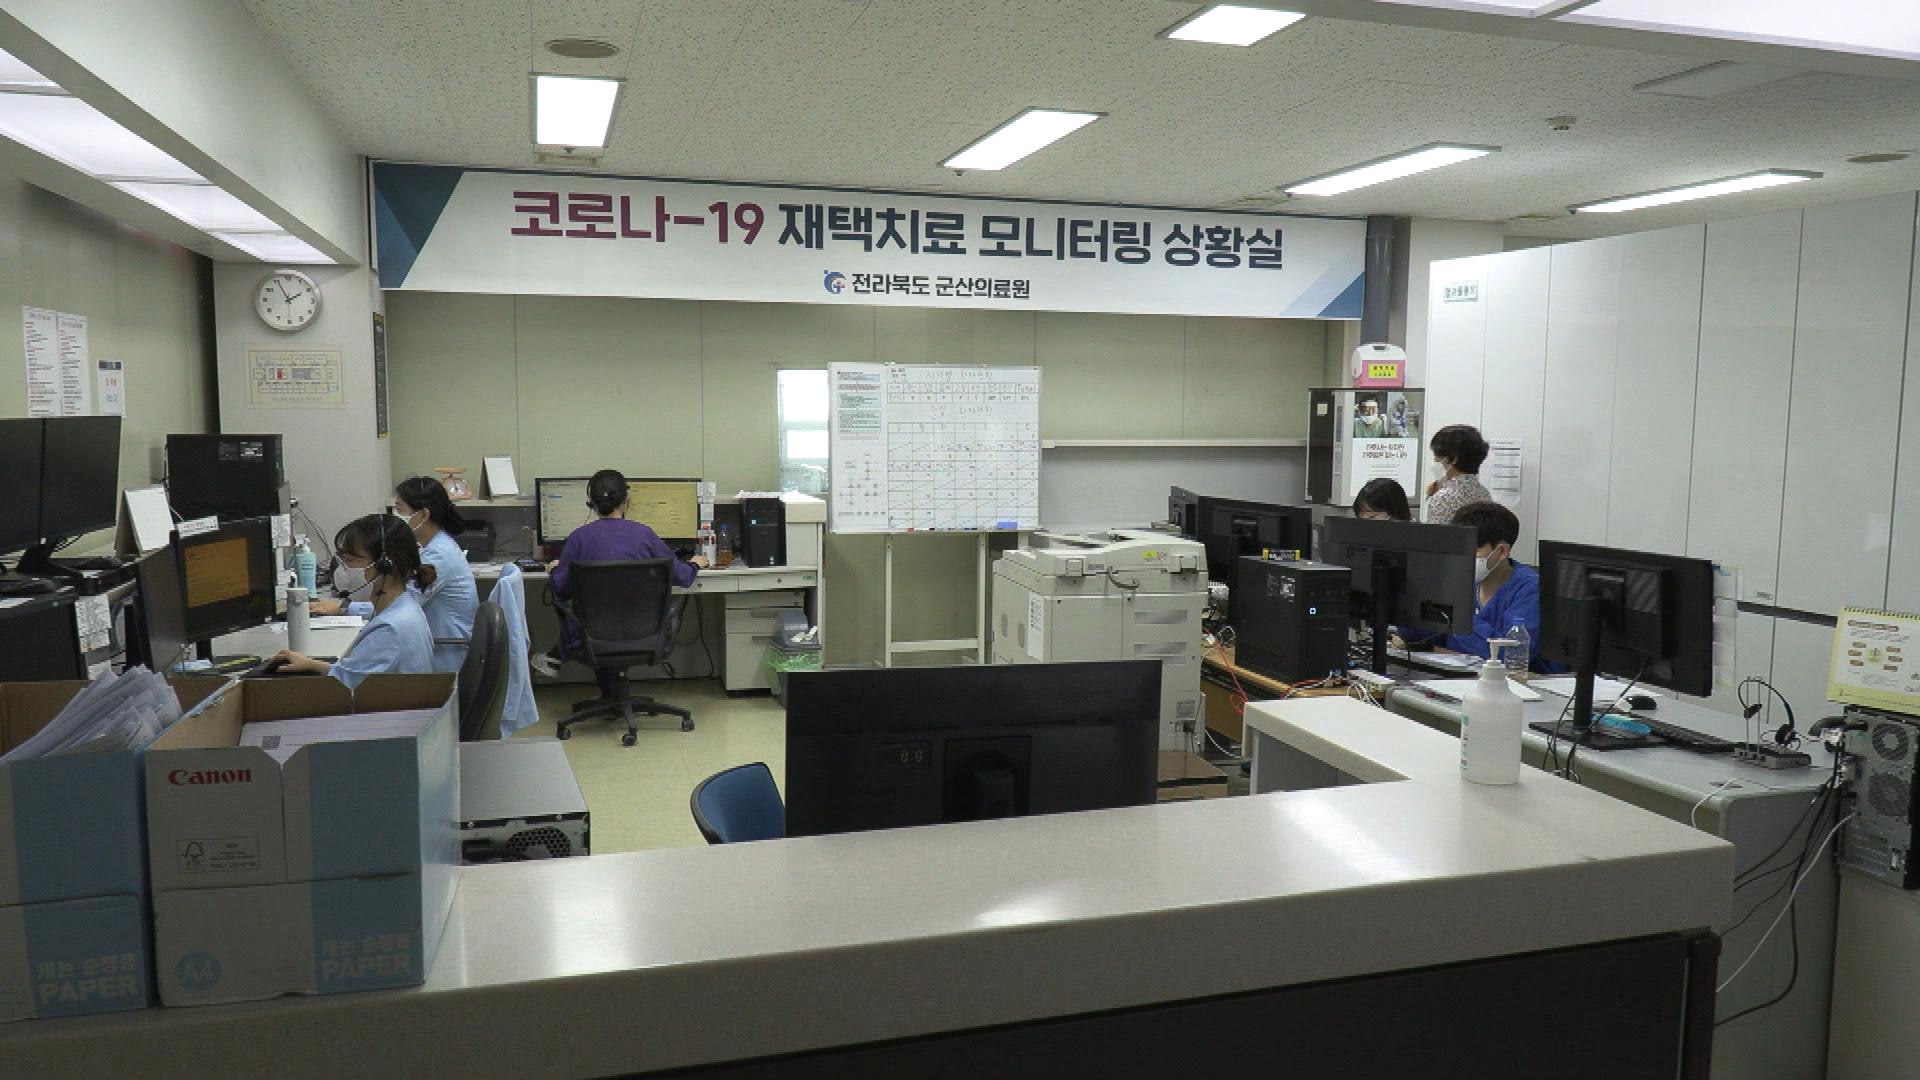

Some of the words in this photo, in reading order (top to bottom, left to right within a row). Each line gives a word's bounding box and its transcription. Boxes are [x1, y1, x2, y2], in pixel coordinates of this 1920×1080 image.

[511, 190, 764, 244] 코로나-19
[778, 203, 967, 253] 재택치료
[979, 215, 1151, 264] 모니터링
[1163, 223, 1283, 270] 상황실
[852, 273, 930, 295] 전라북도
[935, 275, 1030, 299] 군산의료원
[167, 768, 252, 786] Canon
[184, 961, 213, 981] A4
[322, 954, 411, 979] PAPER
[39, 976, 138, 1004] PAPER
